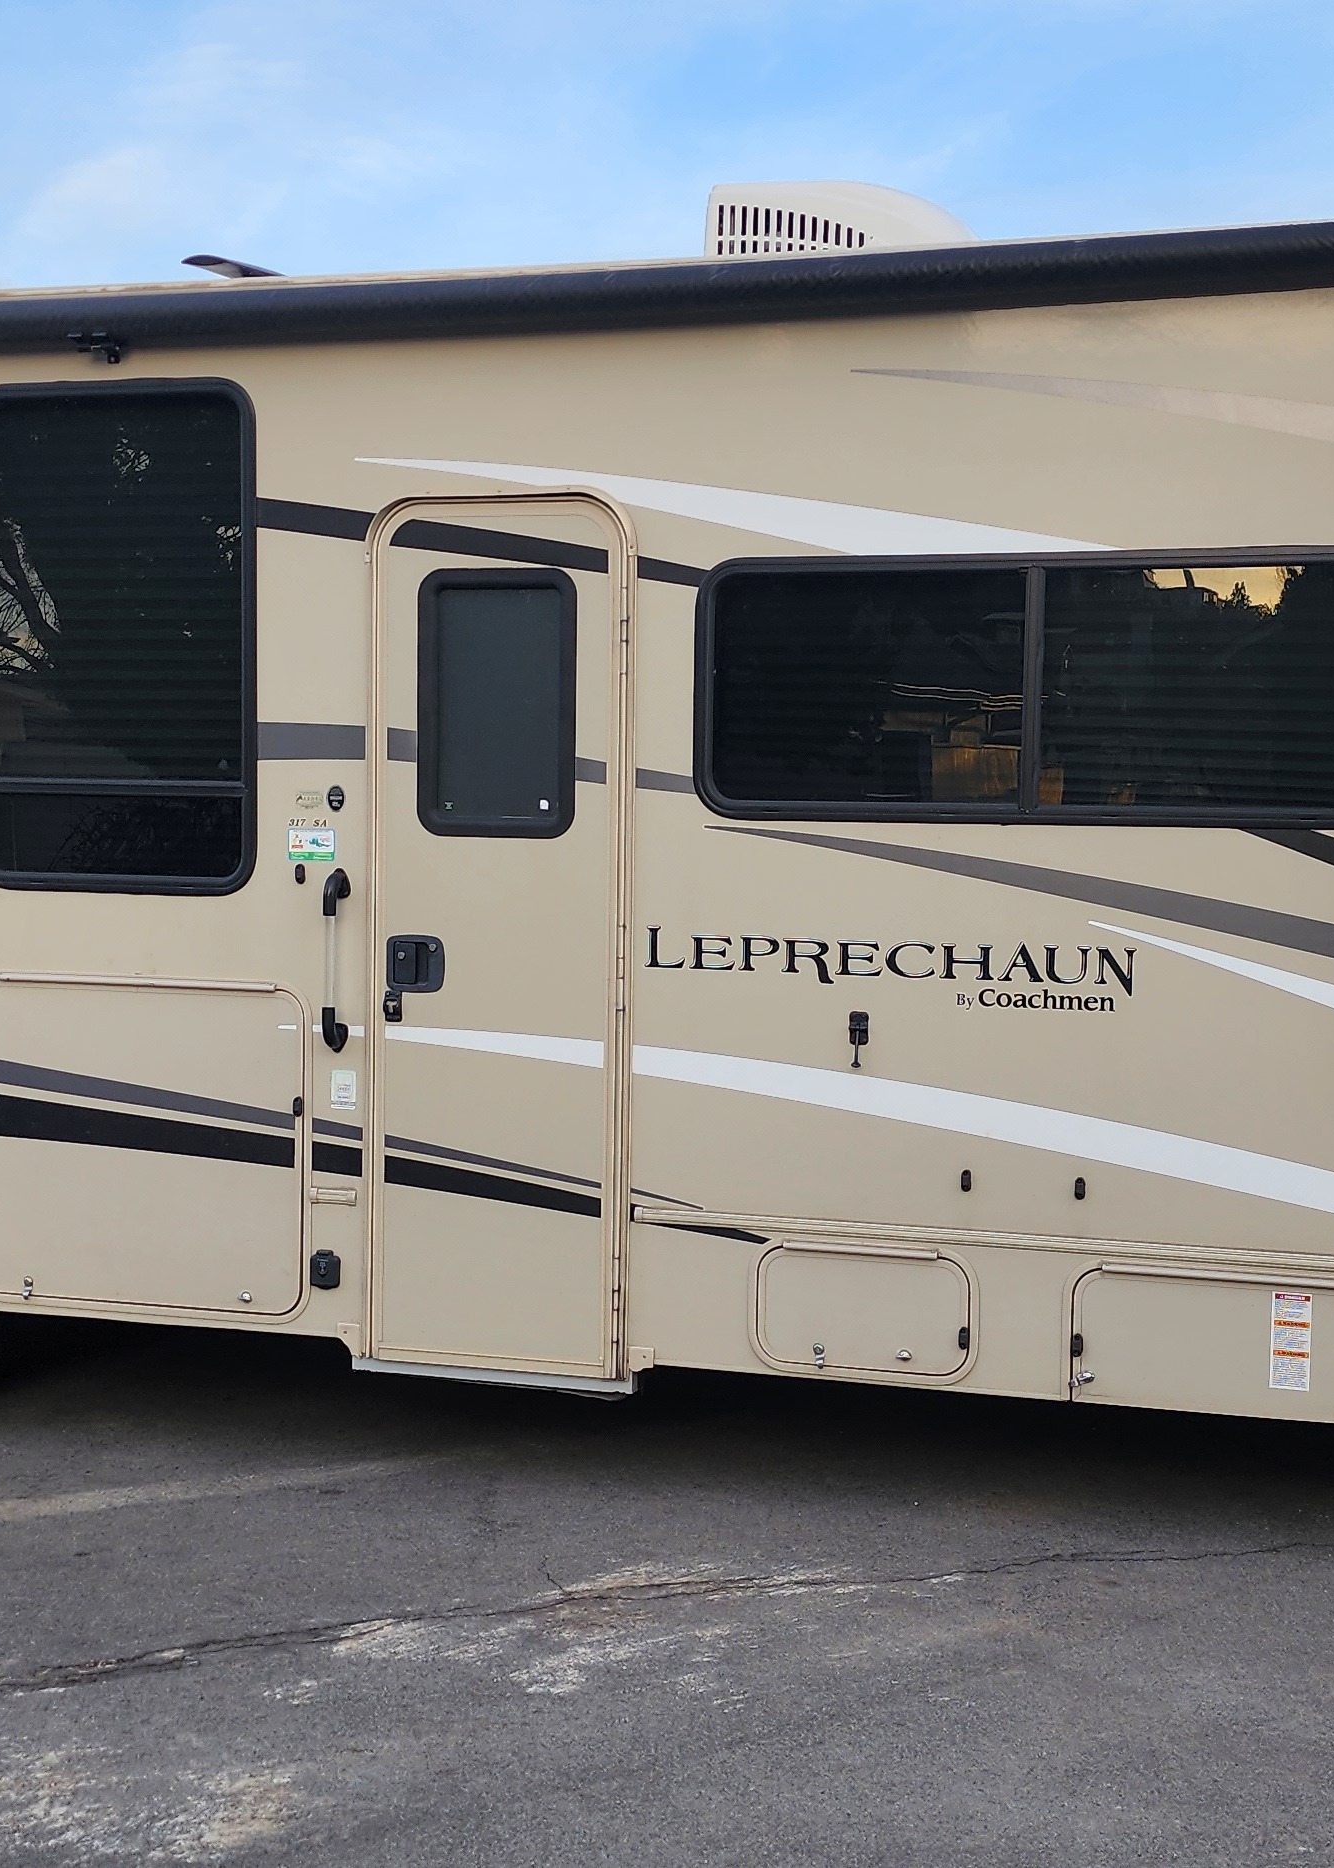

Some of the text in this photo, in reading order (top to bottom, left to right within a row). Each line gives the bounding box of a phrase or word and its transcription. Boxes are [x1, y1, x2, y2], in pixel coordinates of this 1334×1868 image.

[288, 818, 306, 827] 317
[643, 924, 1137, 997] LEPRECHAUN
[956, 988, 1116, 1012] By Coachmen
